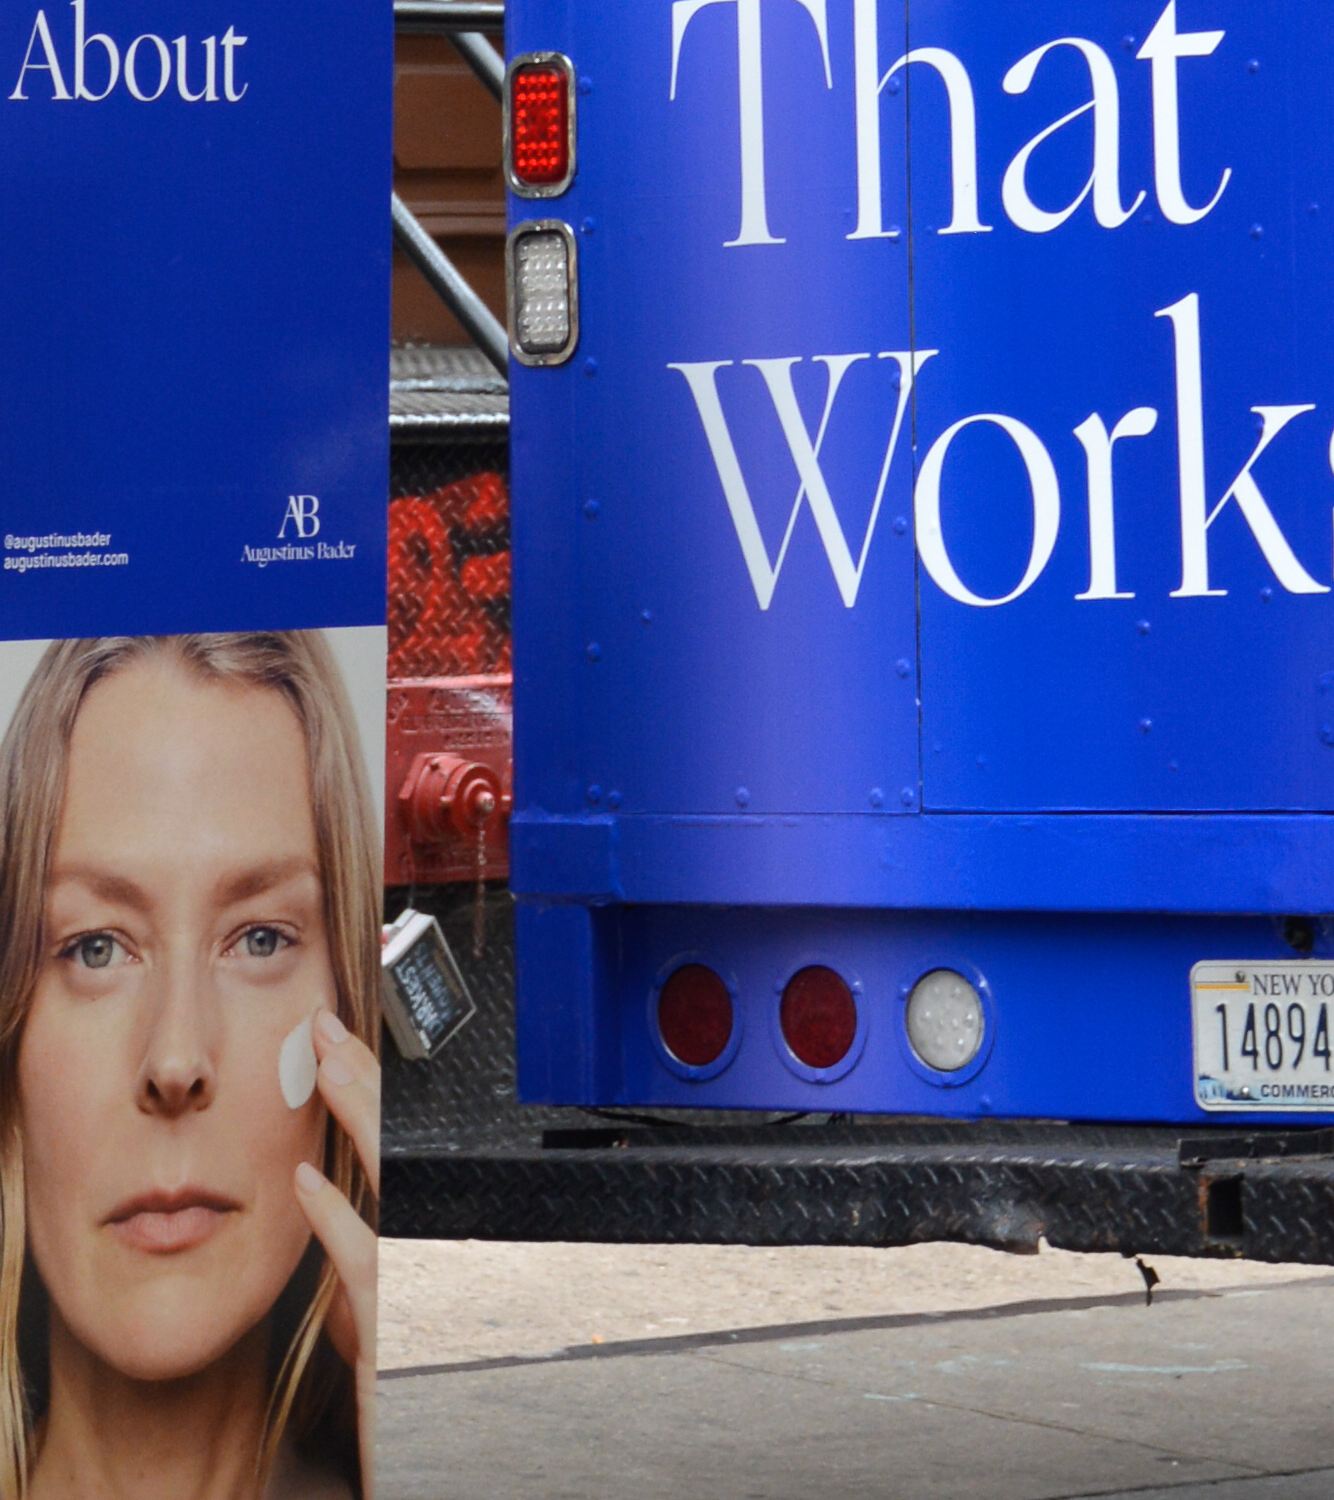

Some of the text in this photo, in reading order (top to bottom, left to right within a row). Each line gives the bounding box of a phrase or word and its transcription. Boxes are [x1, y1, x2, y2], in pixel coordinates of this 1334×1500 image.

[277, 494, 321, 539] AB
[3, 530, 112, 554] @augustinusbader
[241, 541, 357, 568] Augustinus Bader
[3, 551, 129, 573] augustinusbader.com
[1252, 974, 1303, 996] NEW
[1215, 1002, 1332, 1072] 14894
